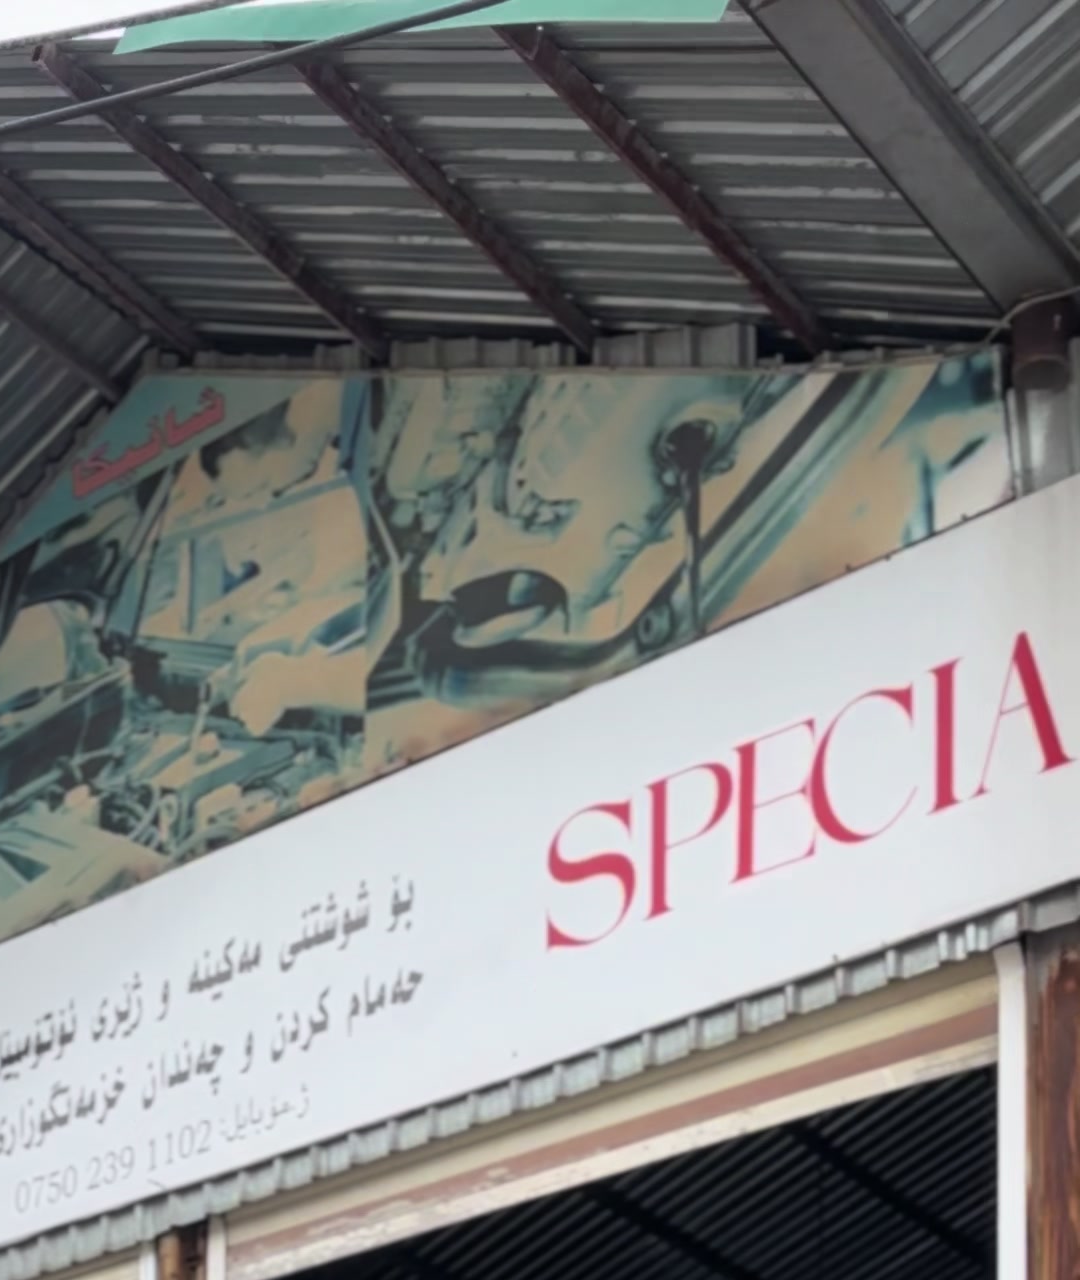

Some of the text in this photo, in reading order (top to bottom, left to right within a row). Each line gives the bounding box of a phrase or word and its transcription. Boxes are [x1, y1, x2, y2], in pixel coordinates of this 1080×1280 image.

[545, 630, 1077, 951] SPECIA
[155, 978, 171, 1023] و
[239, 1029, 254, 1075] و
[13, 1164, 79, 1214] 0750
[86, 1145, 136, 1191] 239
[146, 1119, 213, 1172] 1102
